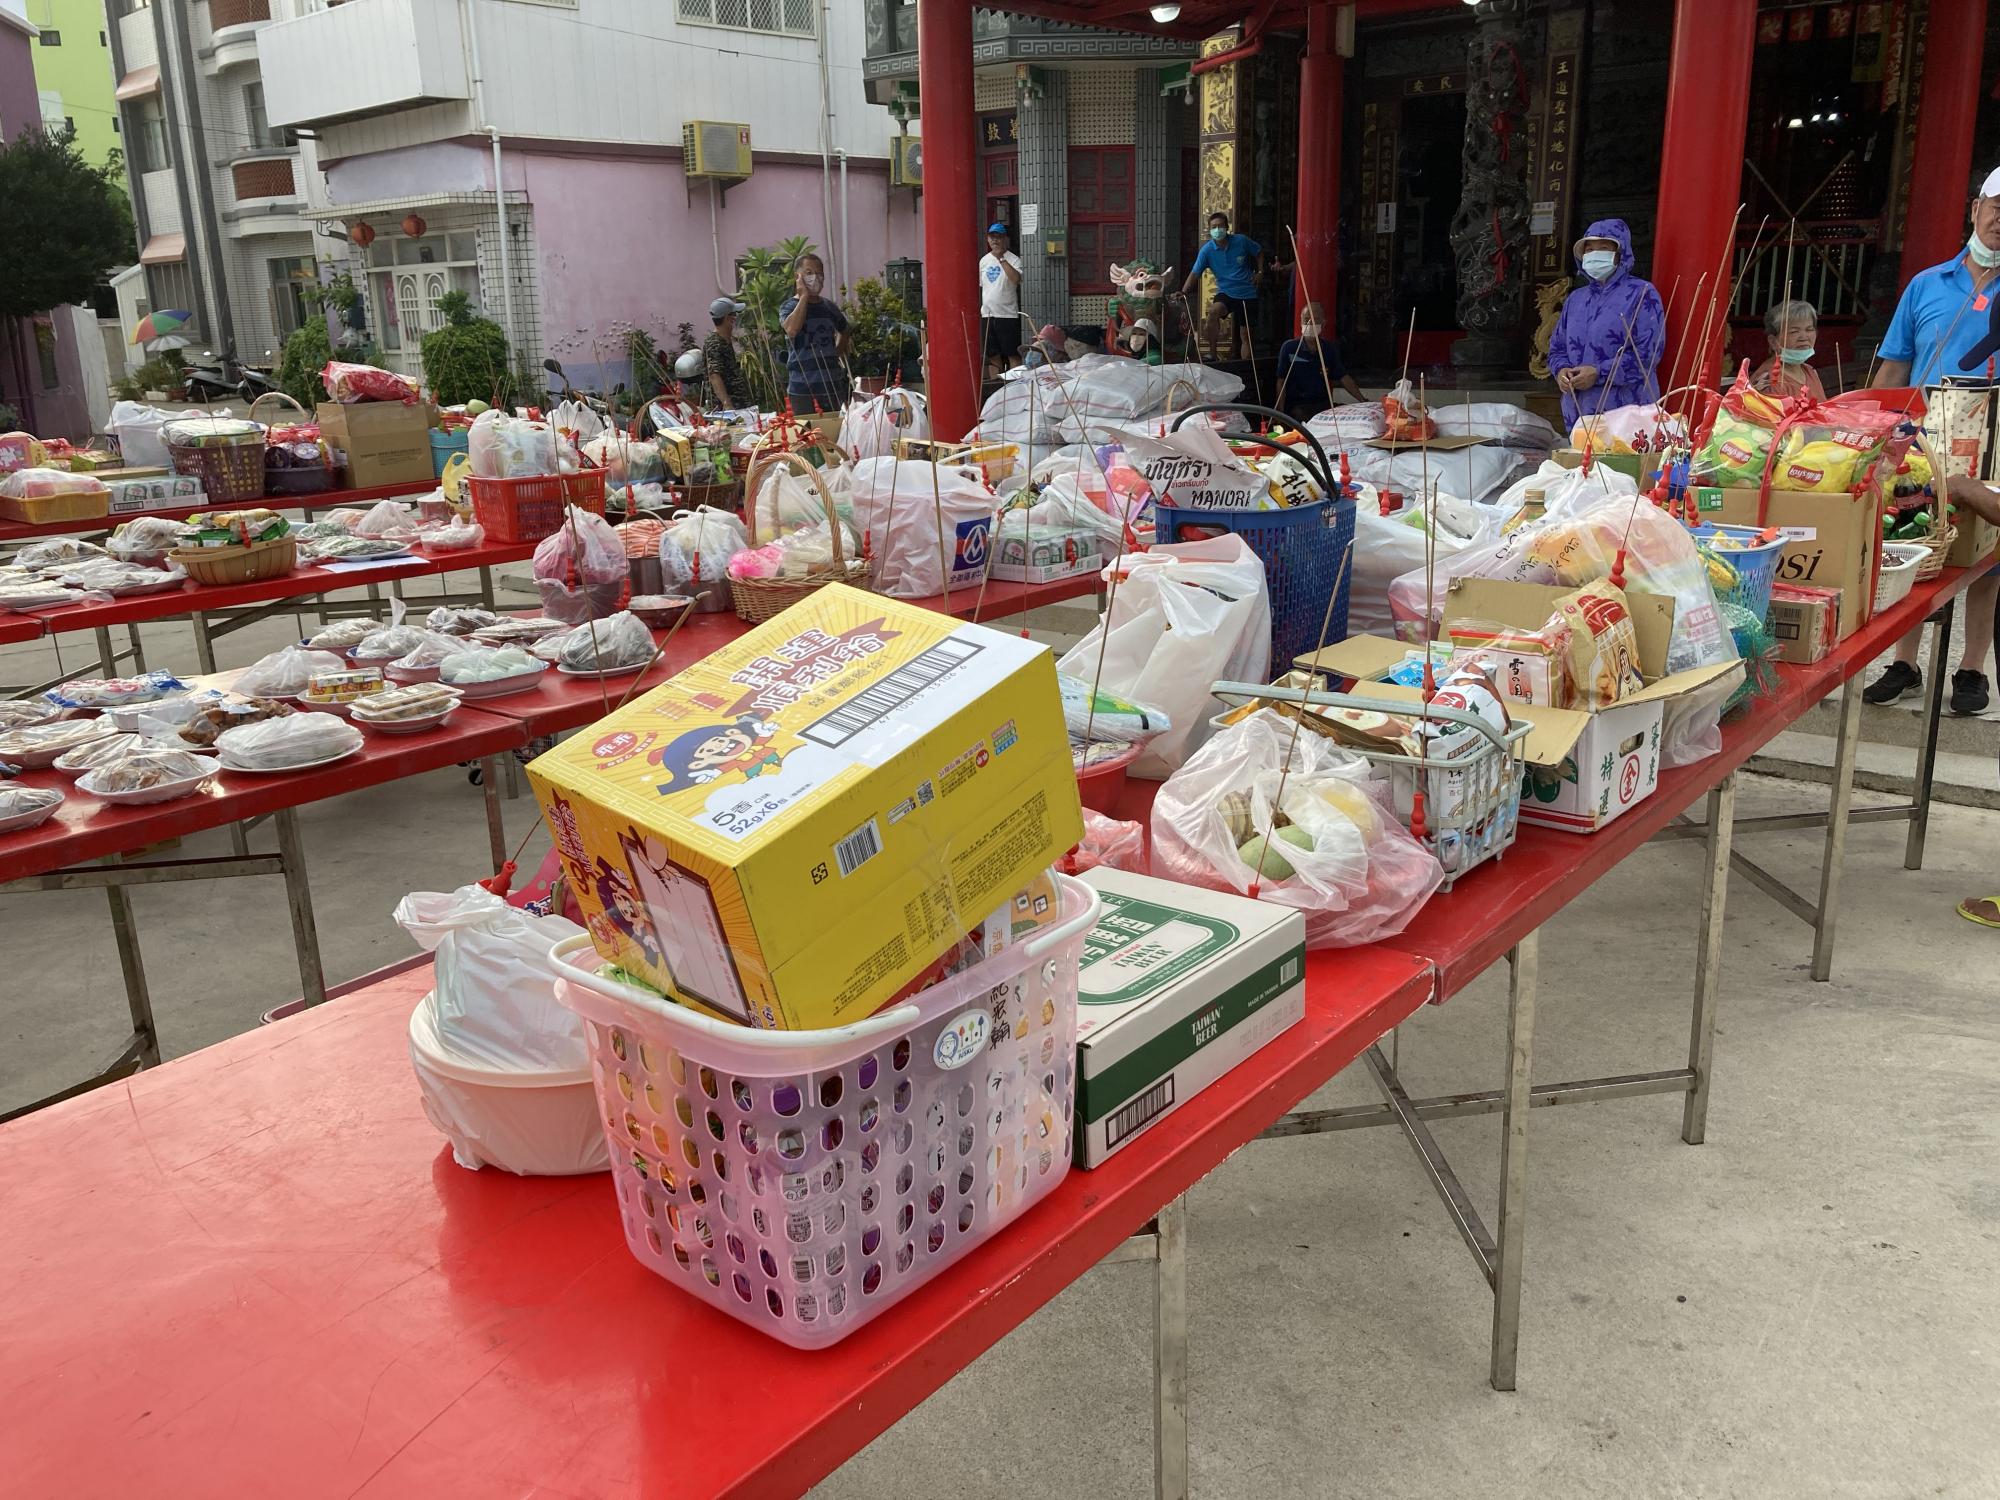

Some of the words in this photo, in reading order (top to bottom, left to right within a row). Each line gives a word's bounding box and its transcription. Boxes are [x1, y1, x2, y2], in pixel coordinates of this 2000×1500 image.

[1776, 549, 1823, 581] si
[730, 627, 838, 690] 開運
[751, 633, 887, 712] 順利箱
[596, 733, 633, 757] 乖乖
[1623, 762, 1637, 798] 金
[1112, 943, 1163, 968] TAIWAN
[1134, 948, 1174, 968] BEER
[1192, 1008, 1222, 1036] TAIWAN
[1195, 1023, 1218, 1047] BEER
